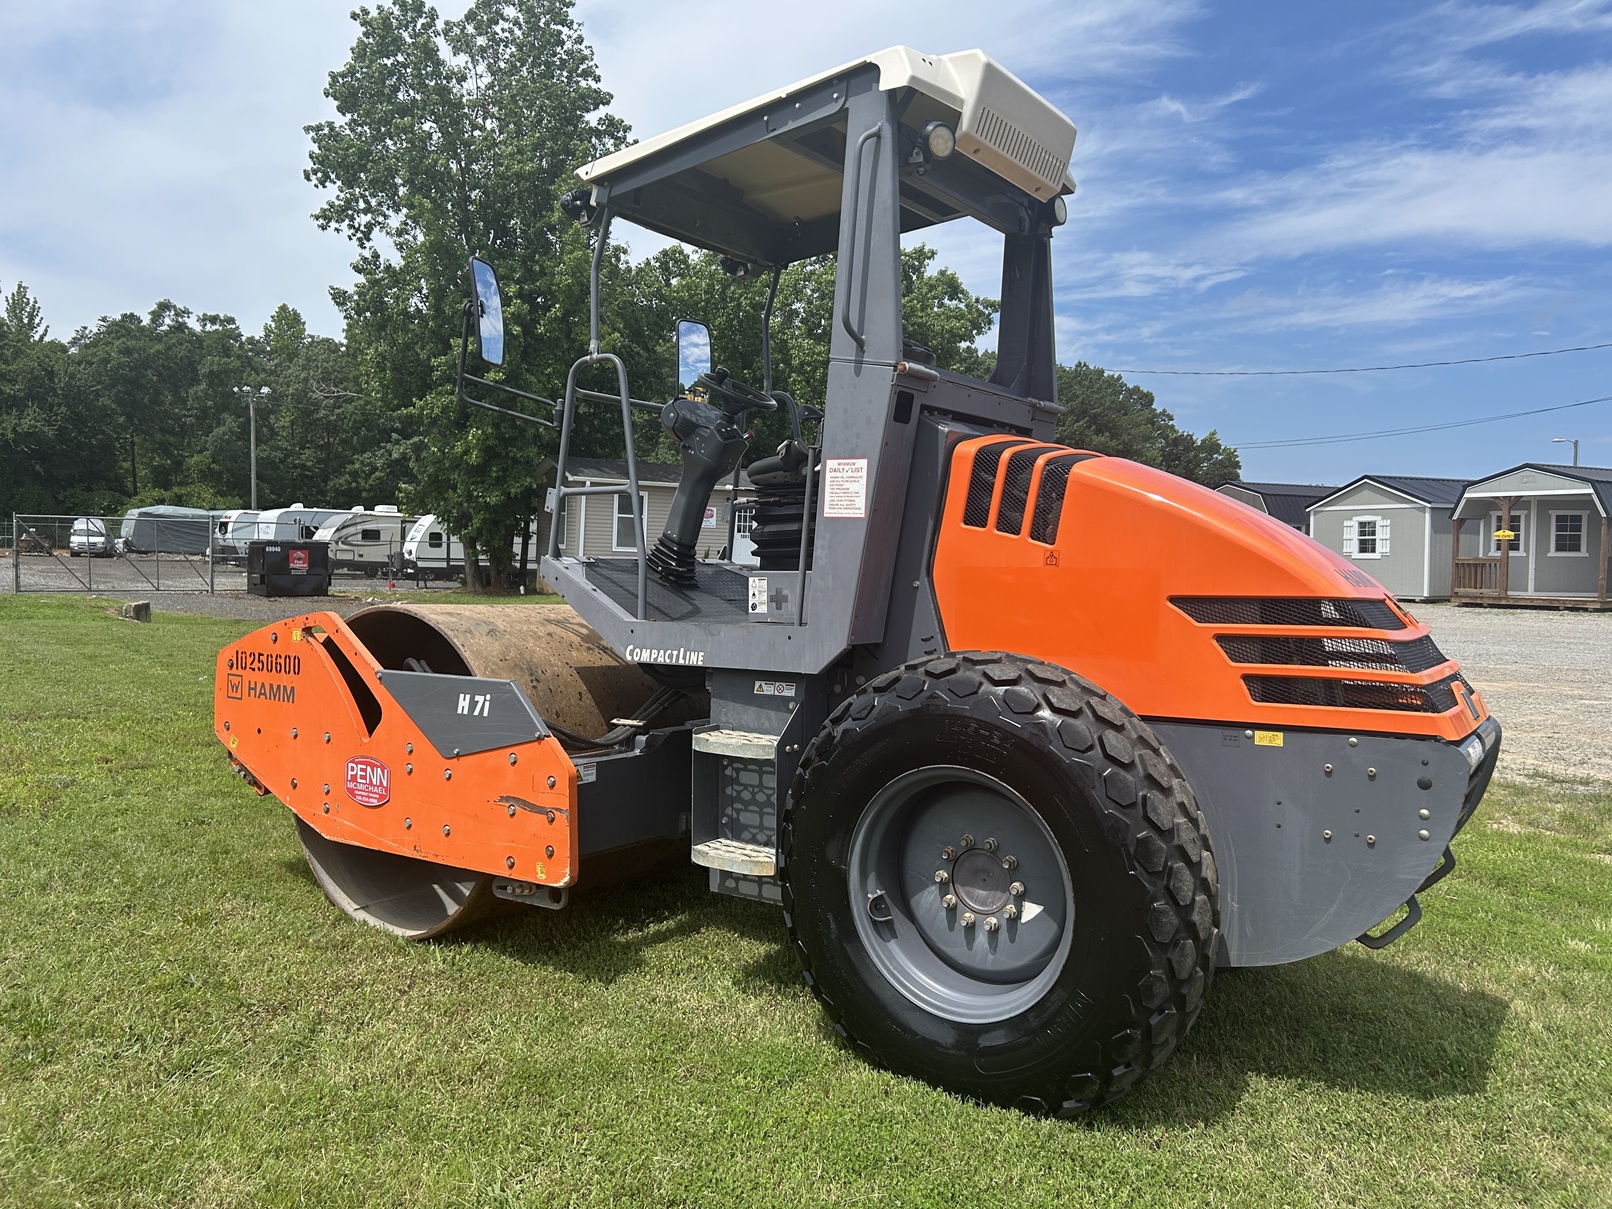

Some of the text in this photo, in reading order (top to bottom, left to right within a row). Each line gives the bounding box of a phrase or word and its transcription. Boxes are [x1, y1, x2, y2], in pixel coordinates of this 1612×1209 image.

[235, 649, 301, 676] 10250600
[247, 680, 295, 704] HAMM
[457, 693, 471, 715] H
[347, 762, 388, 787] PENN
[347, 781, 387, 795] MCMICHAEL
